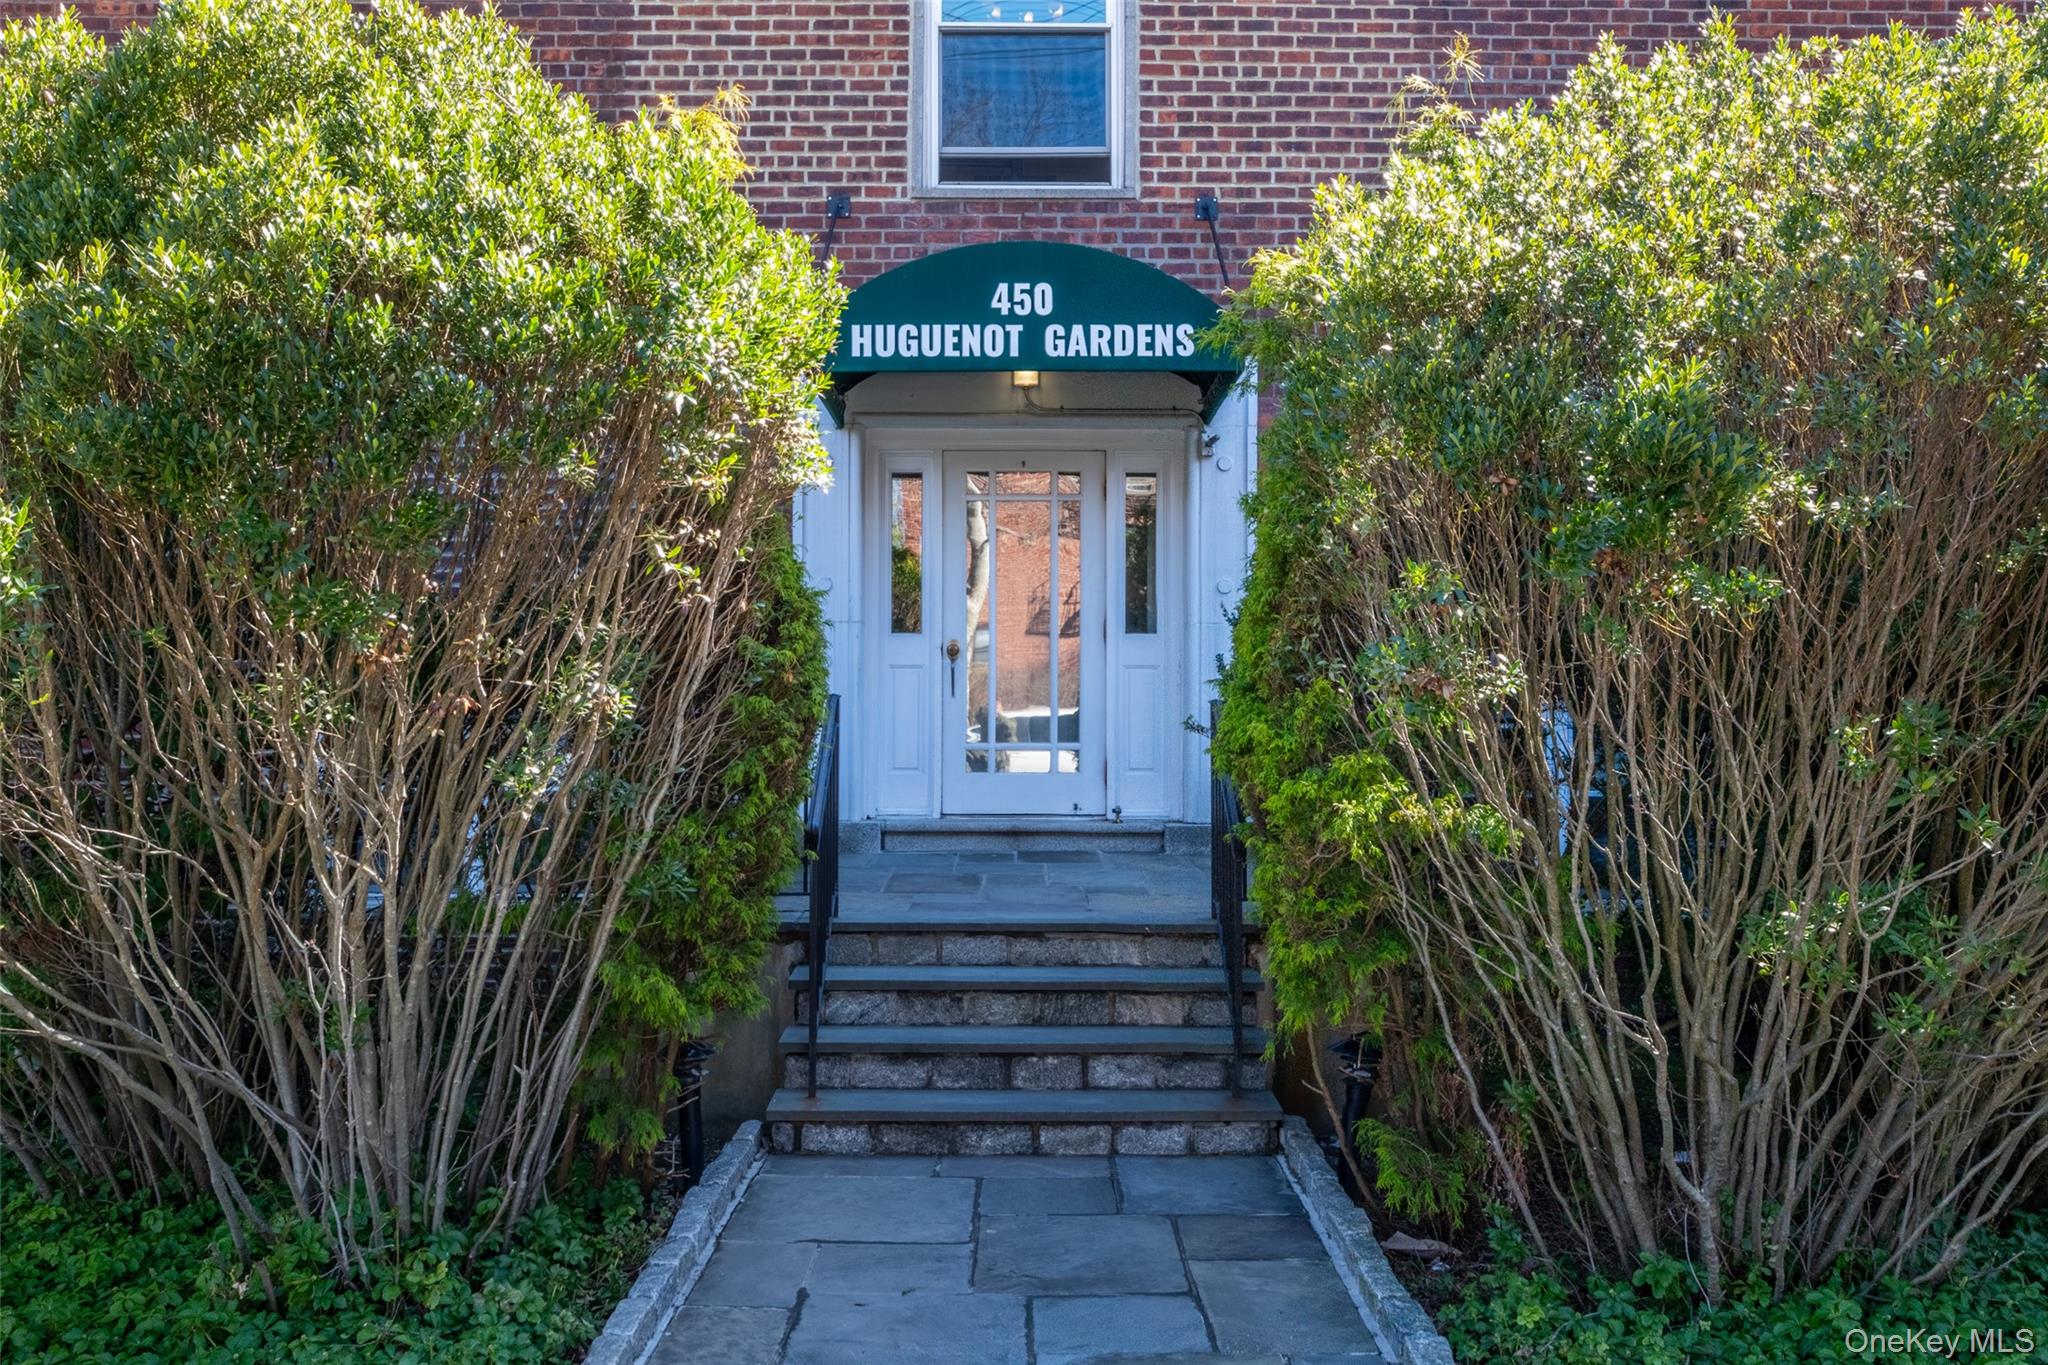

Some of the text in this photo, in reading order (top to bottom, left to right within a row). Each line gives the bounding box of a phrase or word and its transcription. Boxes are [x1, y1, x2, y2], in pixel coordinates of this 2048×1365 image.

[991, 282, 1053, 316] 450
[851, 323, 1195, 358] HUGUENOT GARDENS
